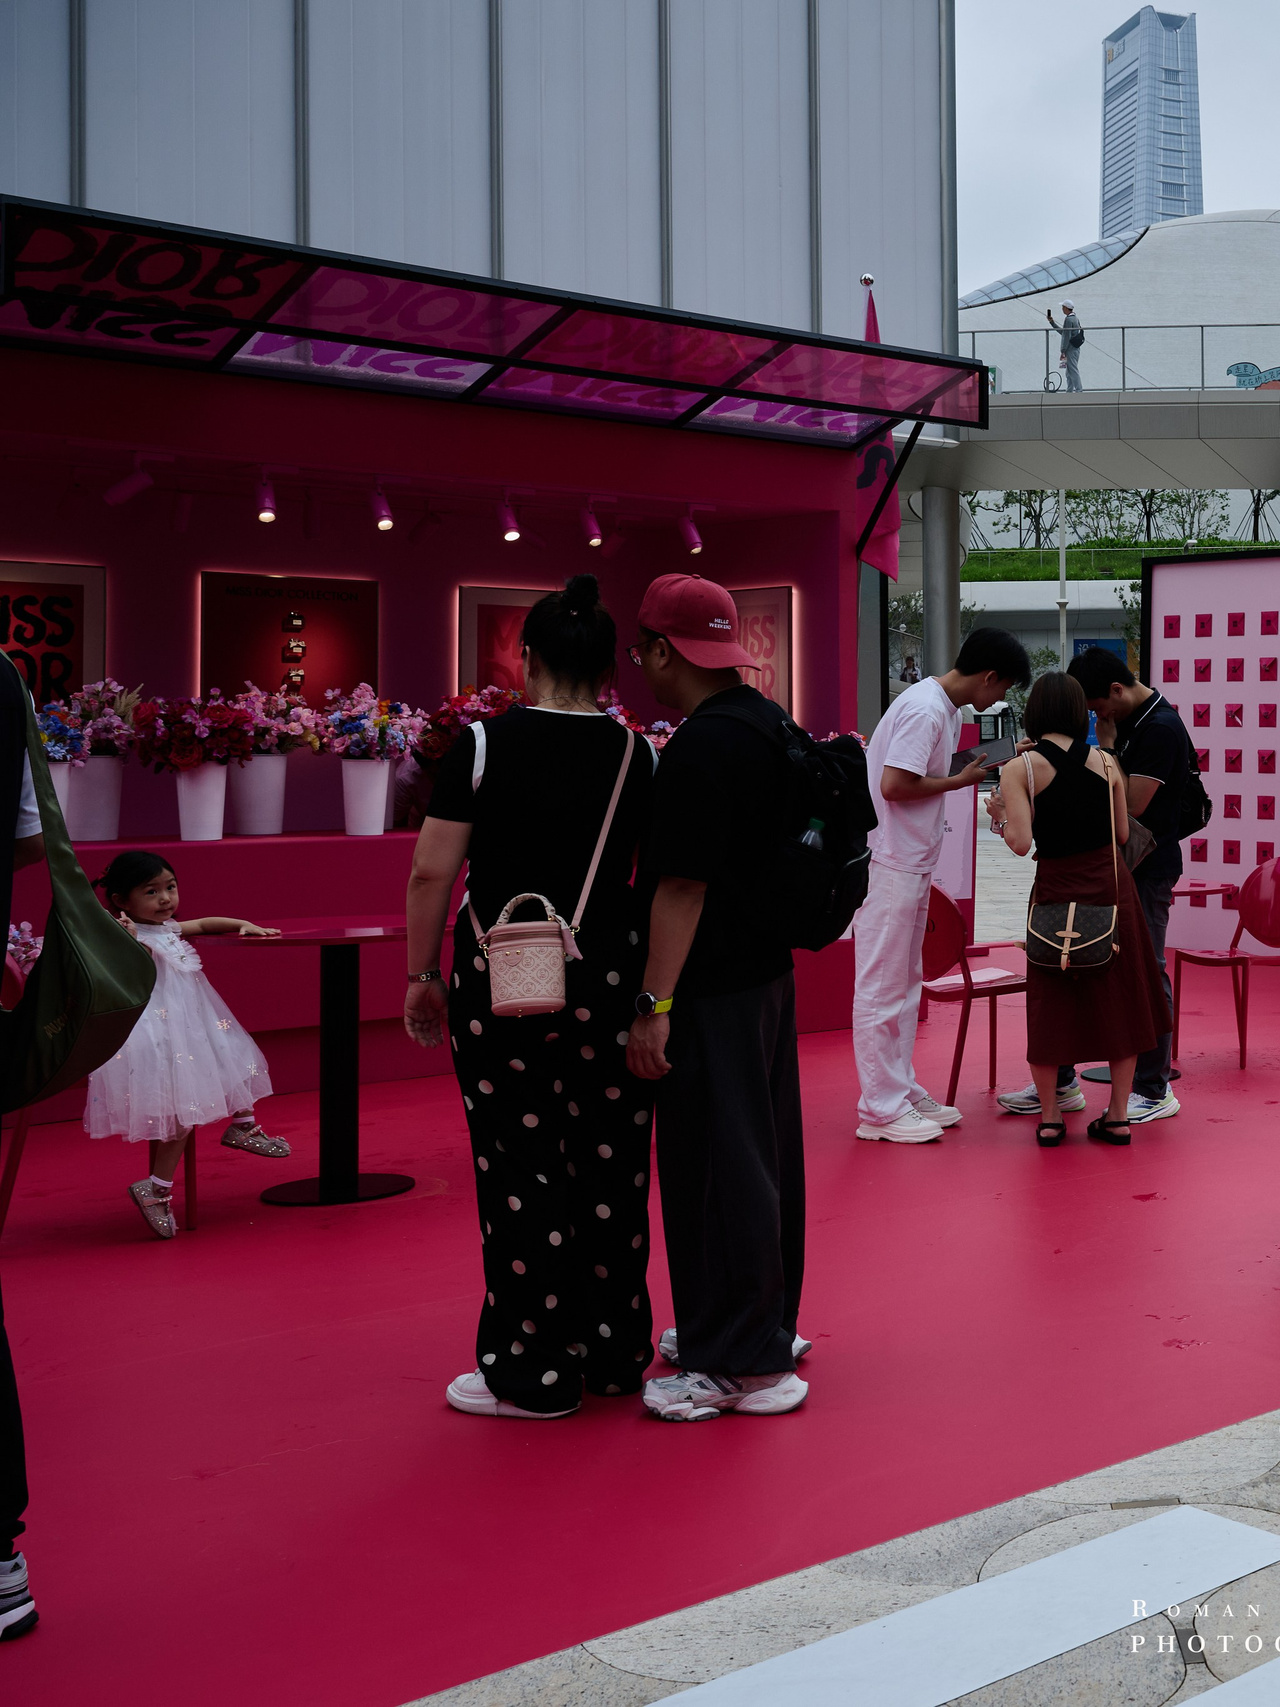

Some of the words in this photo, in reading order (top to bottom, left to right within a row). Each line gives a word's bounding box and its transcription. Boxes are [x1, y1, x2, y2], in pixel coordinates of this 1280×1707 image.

[287, 588, 360, 601] COLLECTION
[708, 622, 732, 630] WEEKEND
[714, 617, 729, 625] HELLO
[738, 615, 776, 660] ISS
